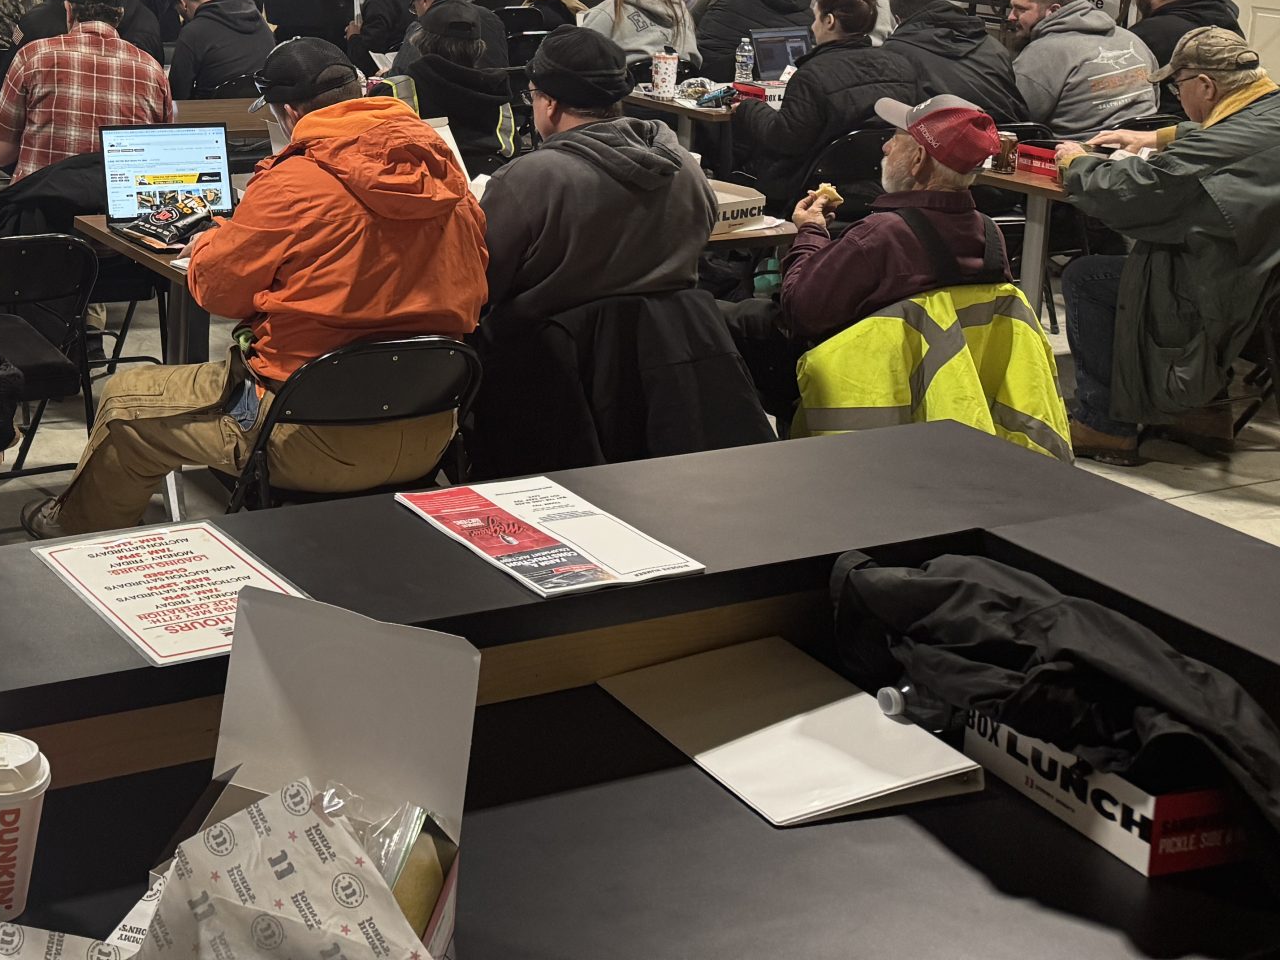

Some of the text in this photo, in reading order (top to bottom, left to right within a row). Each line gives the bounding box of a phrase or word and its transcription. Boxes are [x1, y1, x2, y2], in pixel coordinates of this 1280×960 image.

[916, 123, 940, 149] proxibid
[157, 555, 208, 569] LOADING
[137, 605, 208, 621] OPERATION
[1006, 730, 1153, 845] LUNCH
